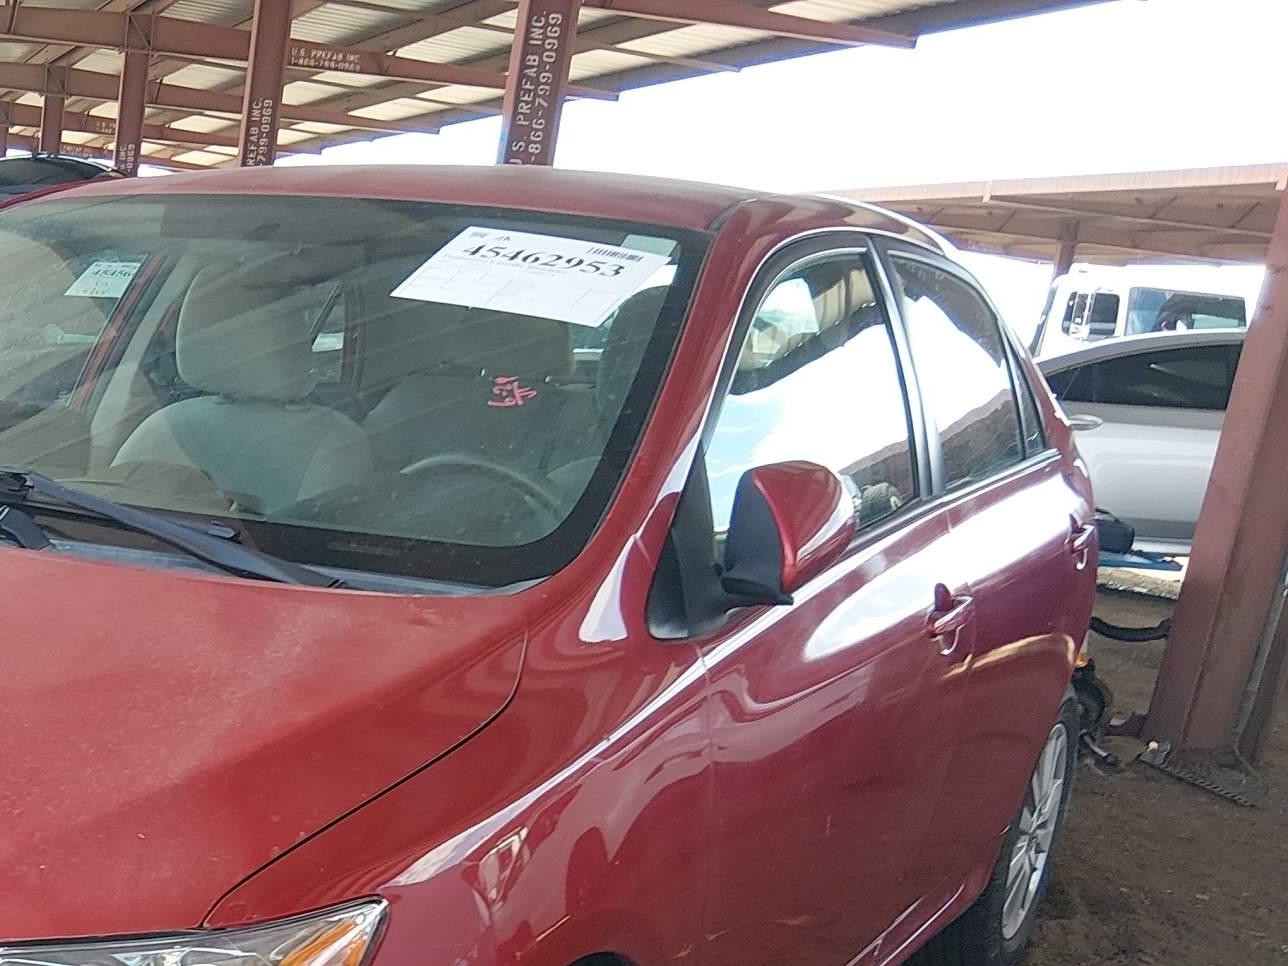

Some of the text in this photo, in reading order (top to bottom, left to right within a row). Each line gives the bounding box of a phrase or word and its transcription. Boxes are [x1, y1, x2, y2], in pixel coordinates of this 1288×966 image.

[311, 48, 343, 61] PREFAB
[516, 54, 539, 126] PREFAB
[528, 11, 547, 45] INC.
[462, 243, 626, 278] 45462953
